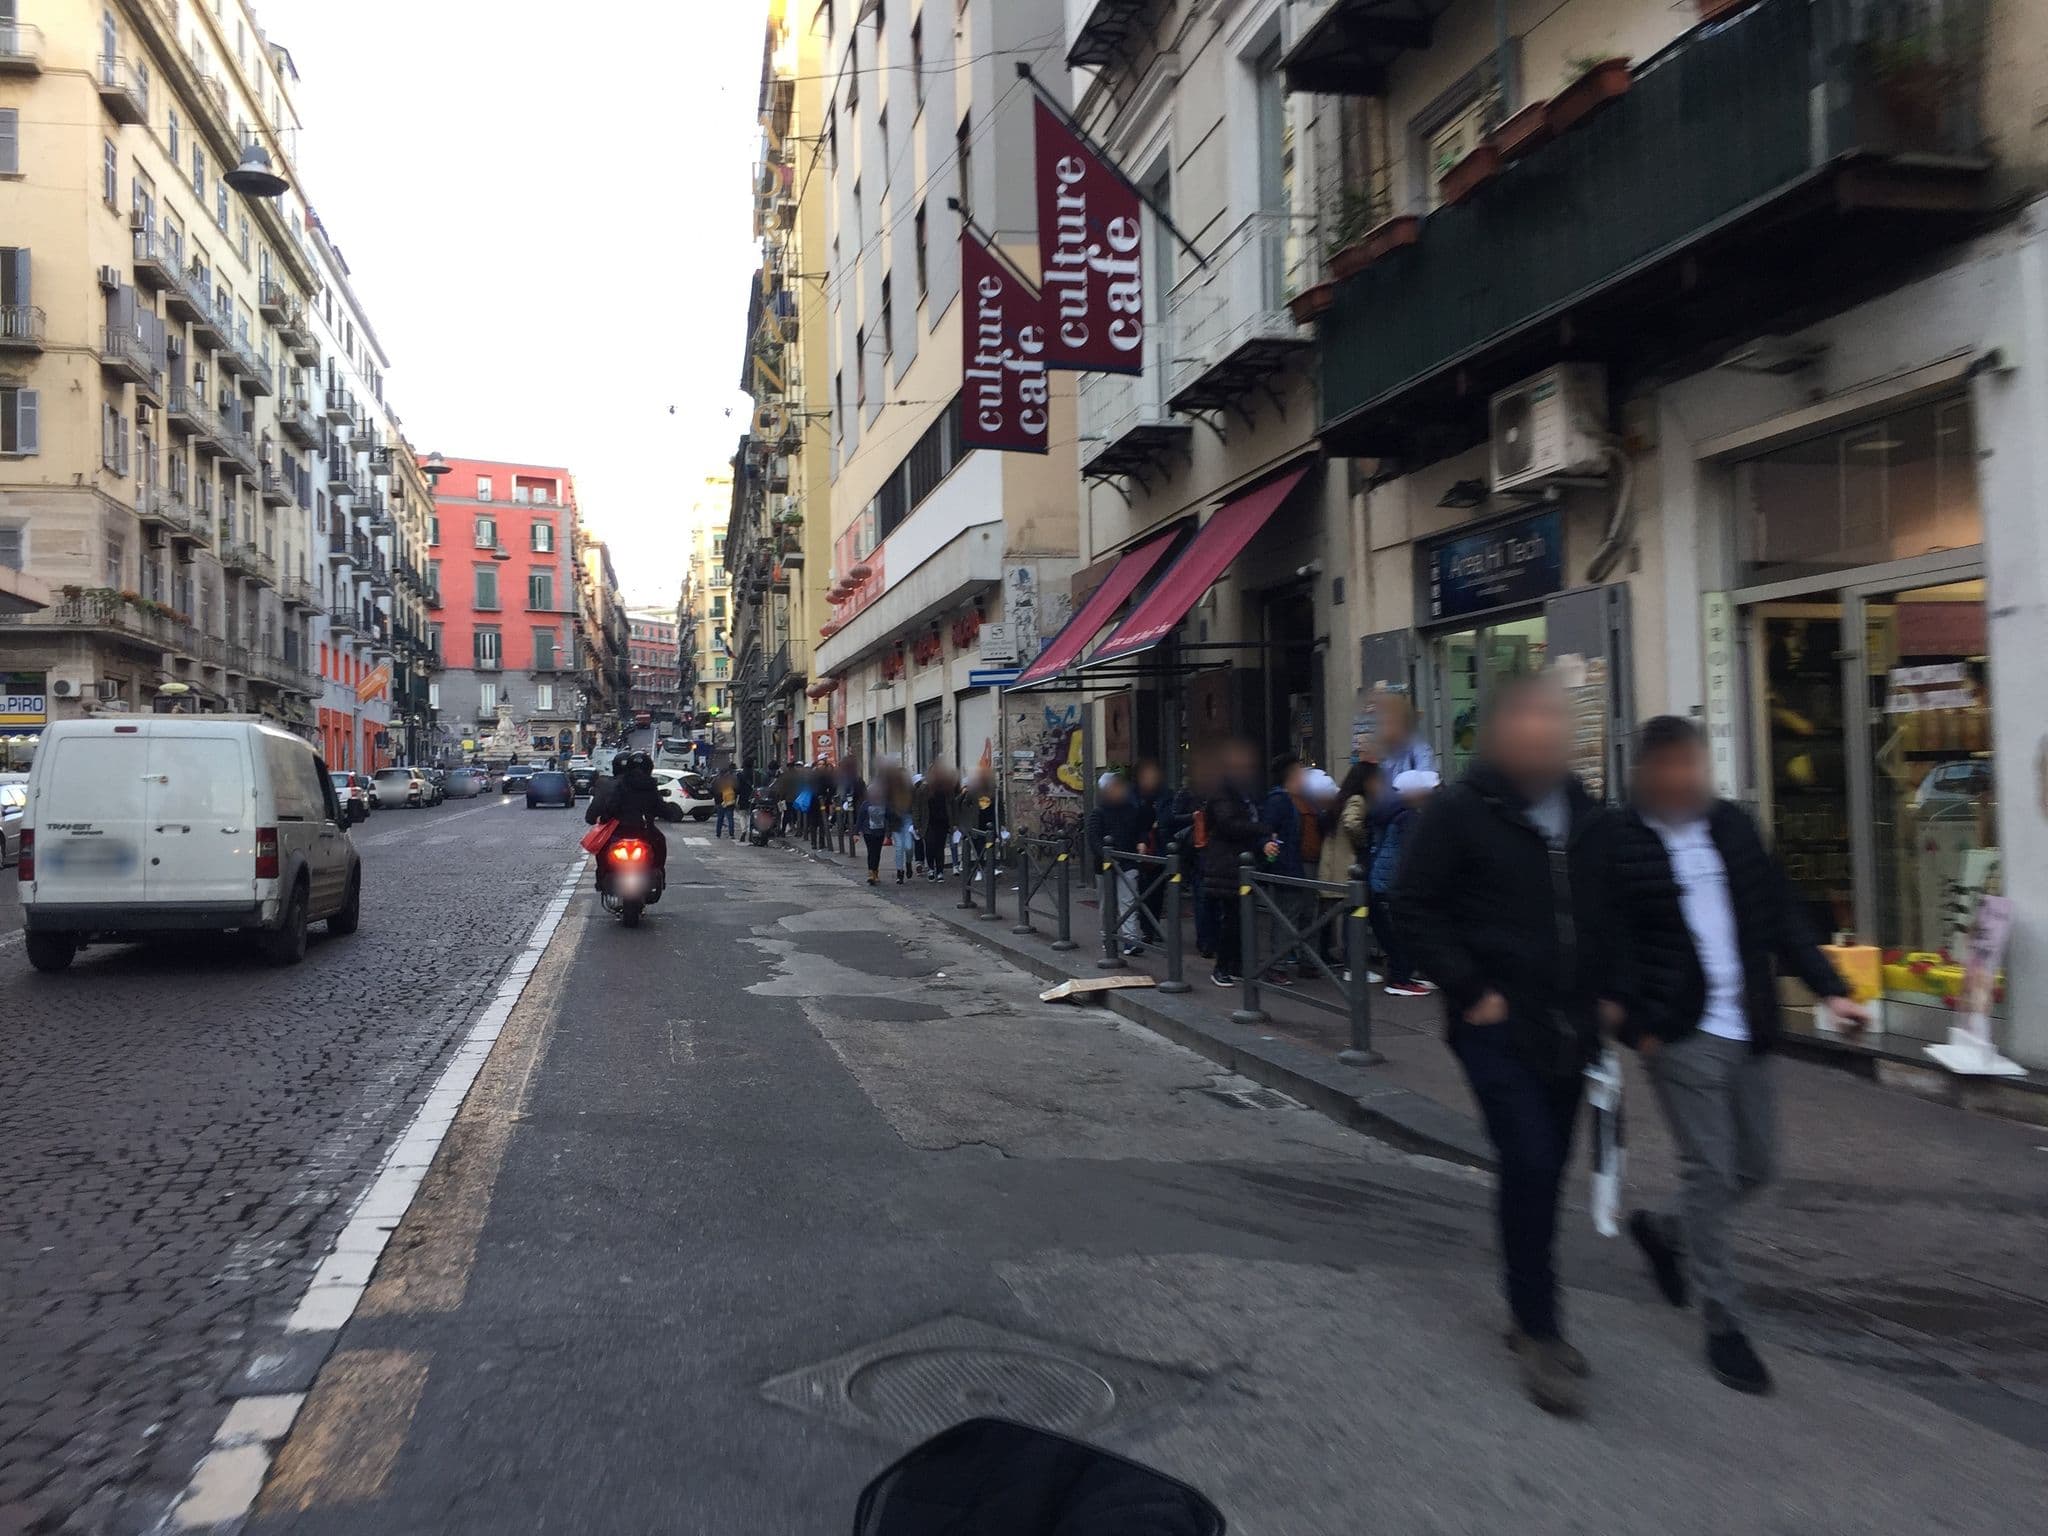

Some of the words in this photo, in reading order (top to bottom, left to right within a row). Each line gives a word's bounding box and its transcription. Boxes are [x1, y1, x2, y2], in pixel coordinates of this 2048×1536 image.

[1044, 155, 1089, 349] culture
[1087, 216, 1144, 352] cafe
[965, 274, 1003, 433] culture
[1001, 324, 1048, 435] cafe
